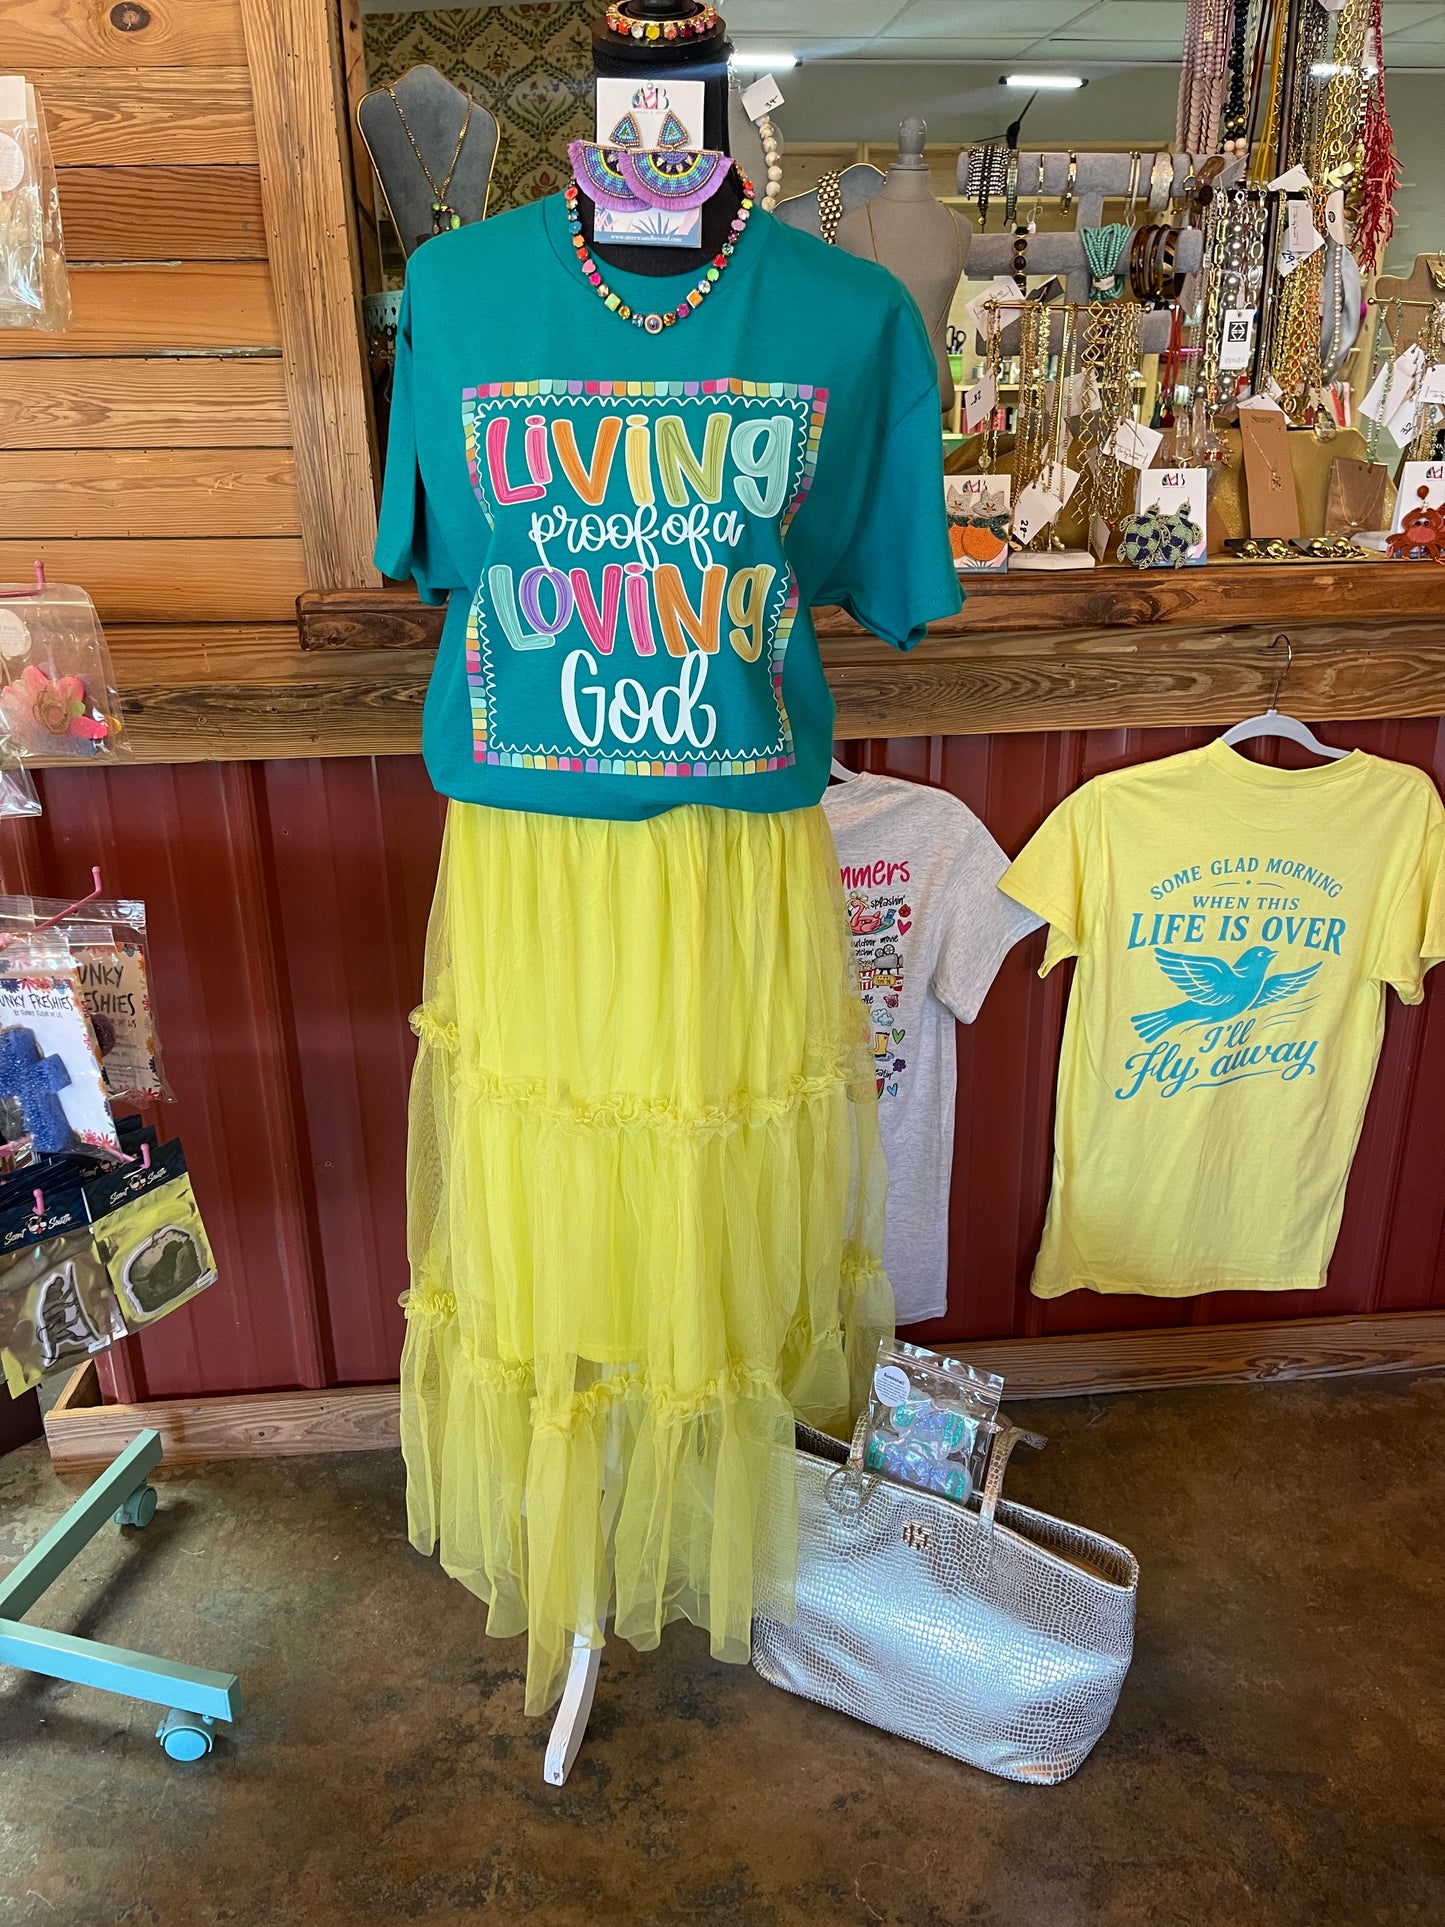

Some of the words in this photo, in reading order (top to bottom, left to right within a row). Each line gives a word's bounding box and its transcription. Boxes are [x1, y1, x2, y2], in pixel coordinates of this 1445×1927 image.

[528, 503, 661, 573] proof
[661, 503, 714, 572] of
[713, 508, 746, 547] a
[561, 649, 717, 749] God
[1150, 865, 1202, 901] SOME
[1210, 857, 1259, 877] GLAD
[1264, 857, 1344, 900] MORNING
[1192, 895, 1249, 910] WHEN
[1256, 896, 1300, 911] THIS
[1126, 912, 1207, 951] LIFE
[1218, 914, 1250, 942] IS
[1261, 915, 1347, 956] OVER
[28, 993, 74, 1011] FRESHIES
[1199, 1017, 1257, 1054] I'll
[1114, 1040, 1200, 1101] Fly
[1210, 1039, 1319, 1082] away
